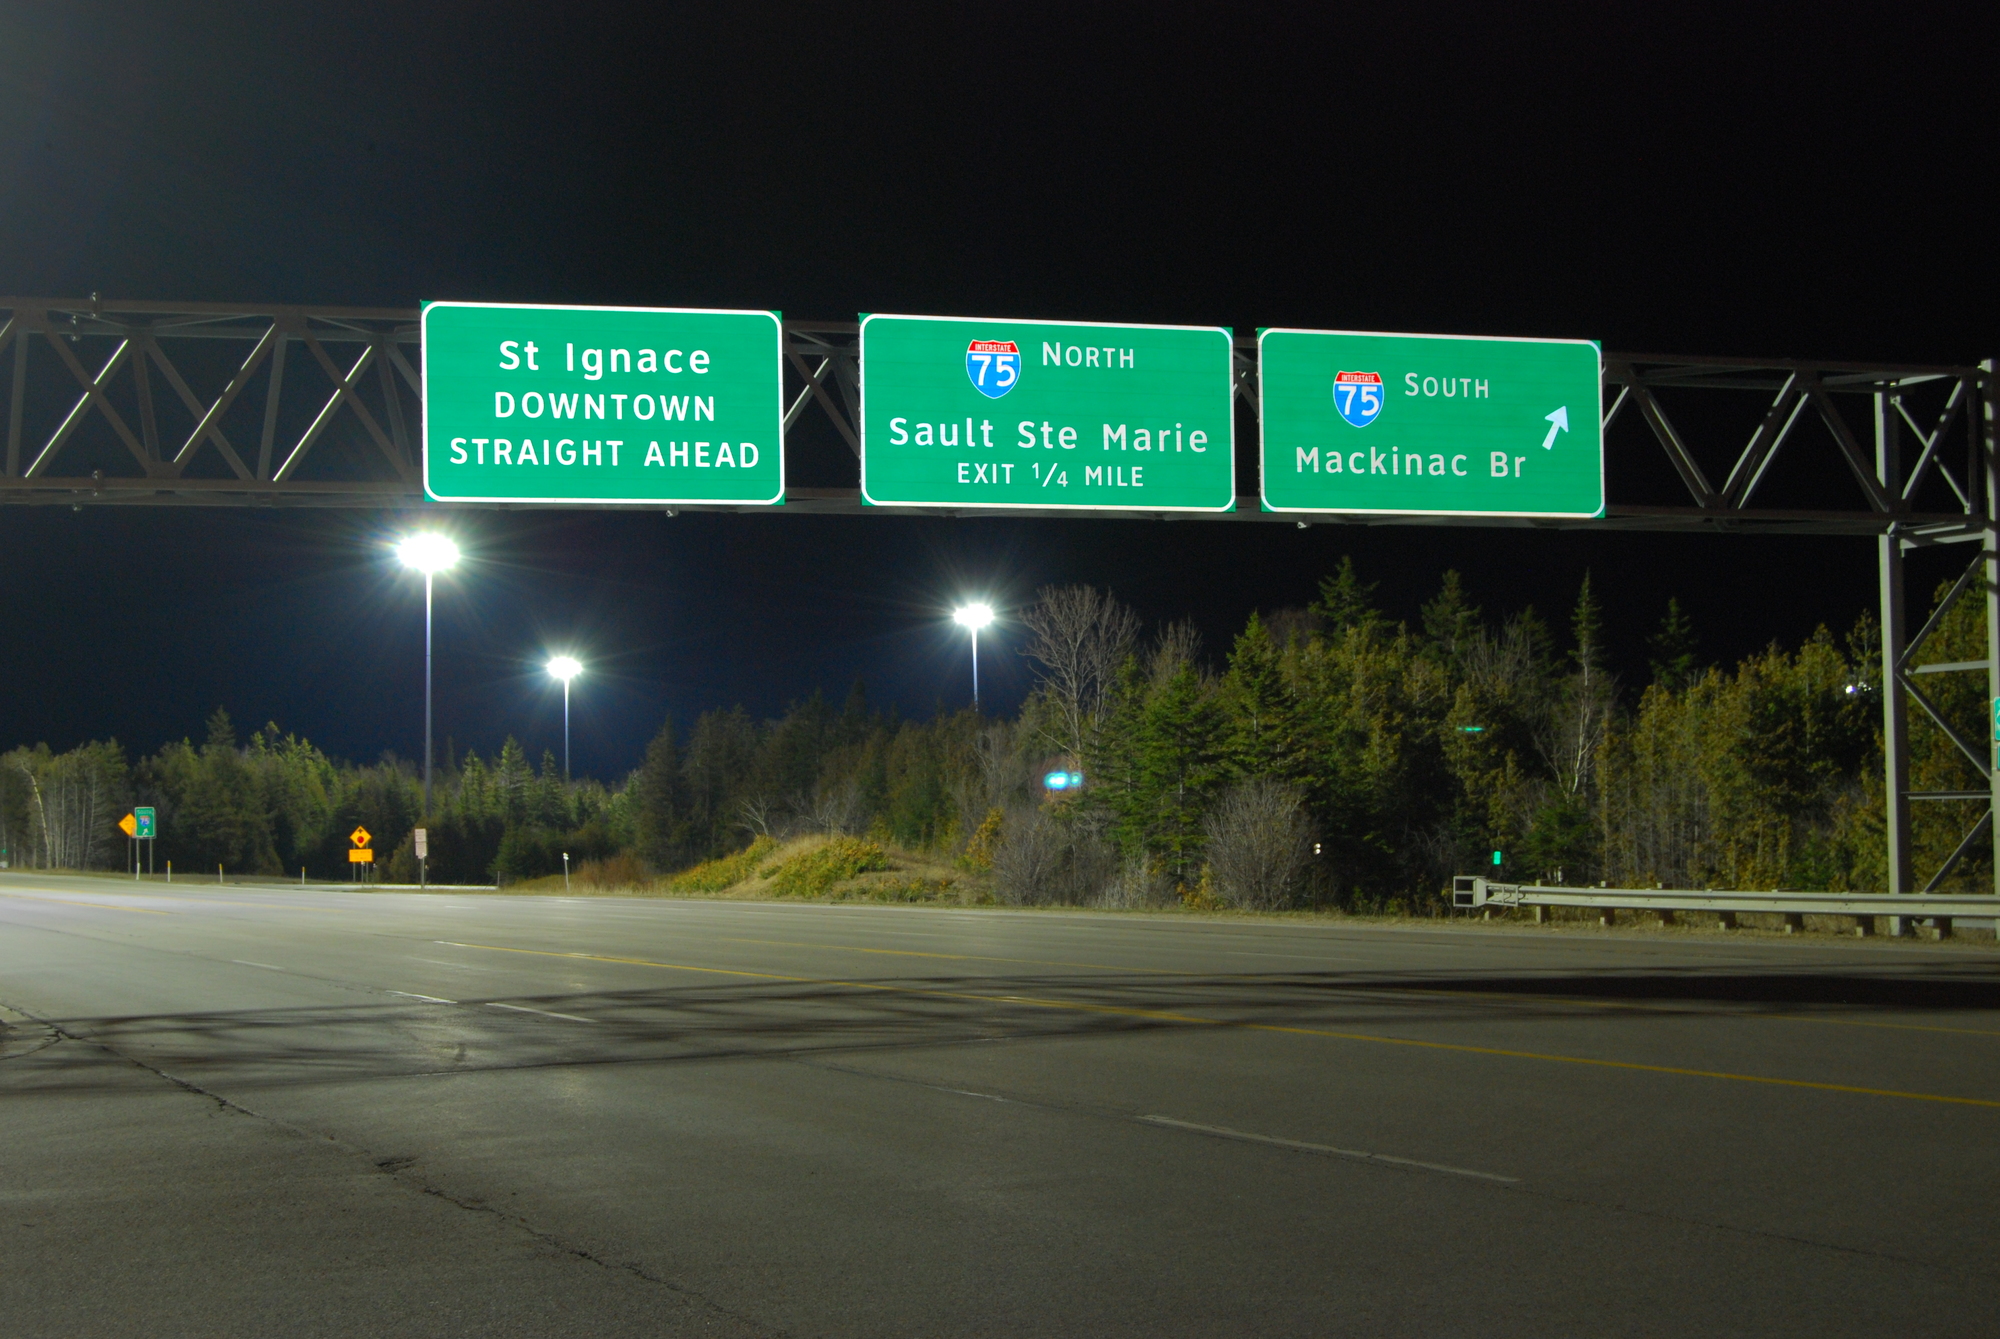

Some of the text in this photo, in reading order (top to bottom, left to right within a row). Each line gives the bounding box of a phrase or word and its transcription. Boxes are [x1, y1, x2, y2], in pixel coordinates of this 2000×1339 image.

[499, 340, 711, 381] St Ignace
[974, 343, 1012, 352] INTERSTATE
[1042, 341, 1135, 369] NORTH
[971, 355, 1016, 387] 75
[1341, 374, 1376, 383] INTERSTATE
[1404, 372, 1490, 399] SOUTH
[494, 391, 715, 422] DOWNTOWN
[1338, 385, 1380, 416] 75
[889, 417, 1208, 453] Sault Ste Marie
[449, 437, 760, 469] STRAIGHT AHEAD
[1296, 445, 1527, 478] Mackinac Br
[957, 462, 1144, 488] EXIT 1/4 MILE
